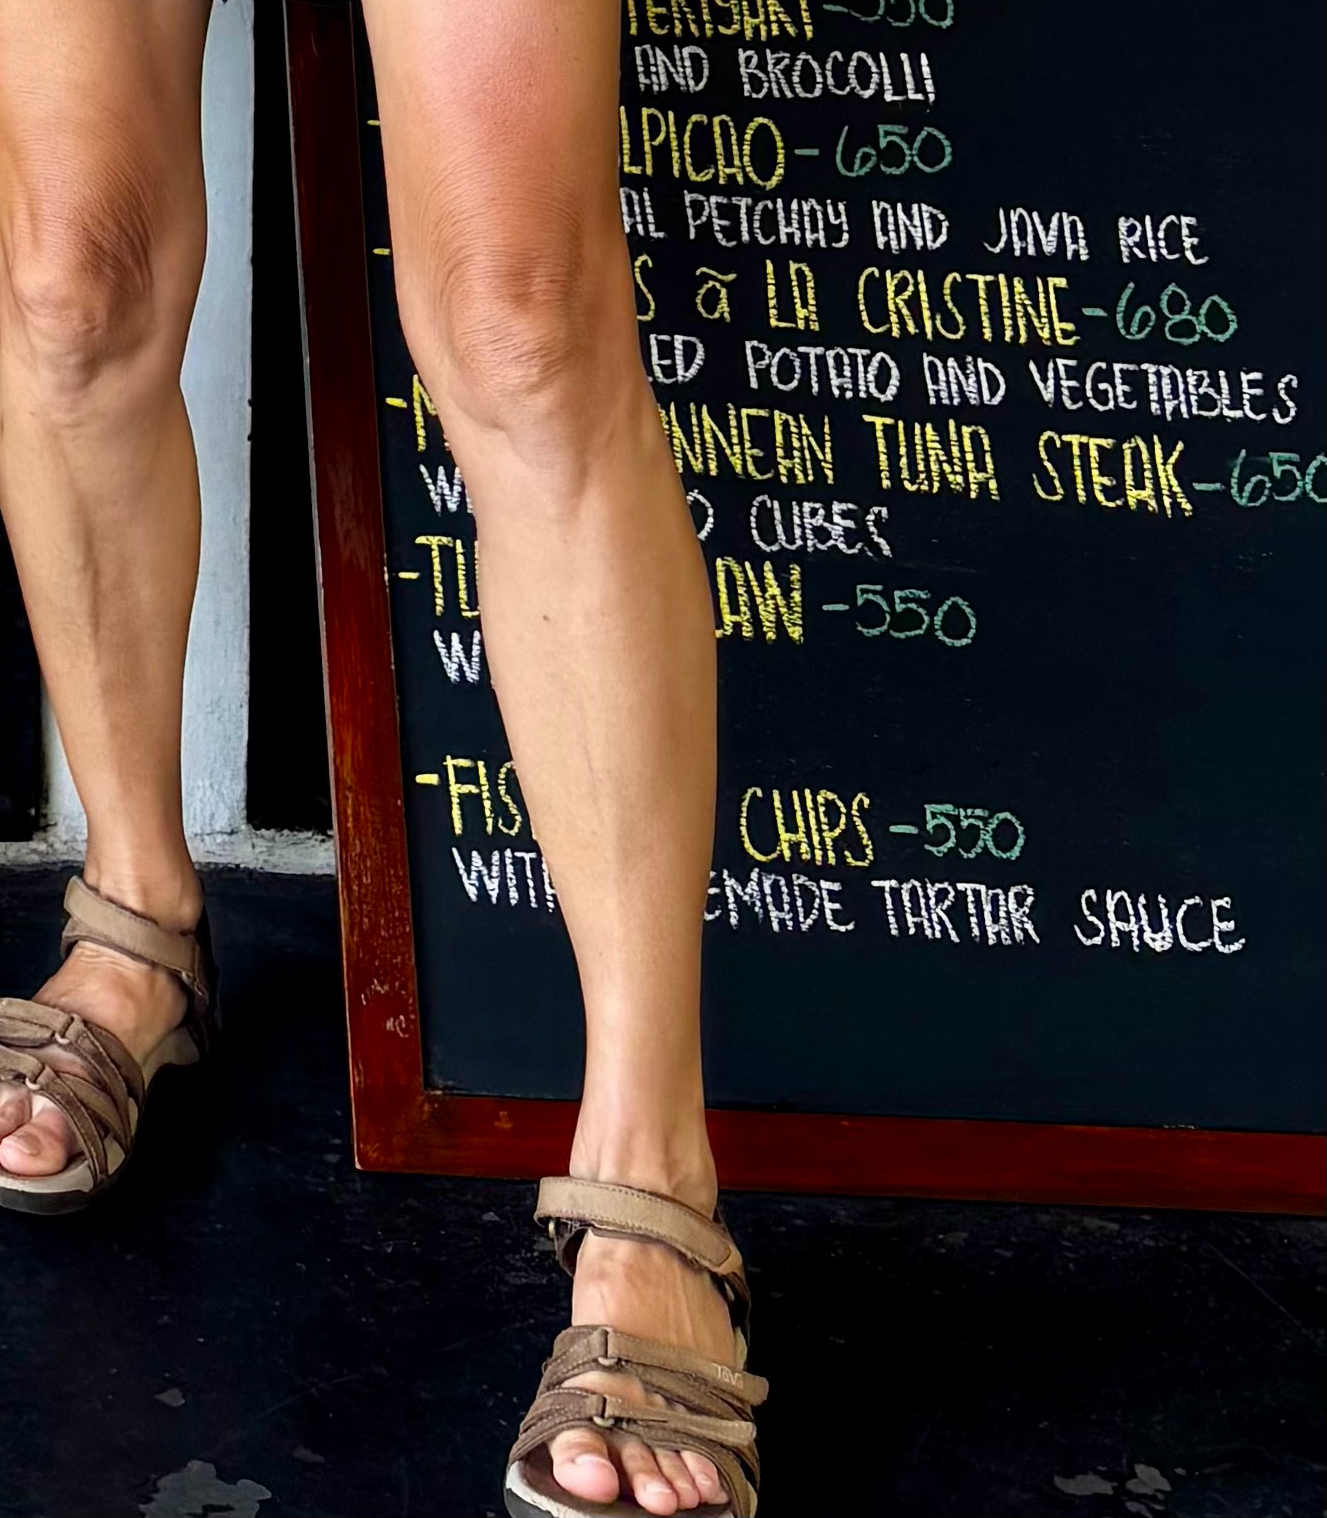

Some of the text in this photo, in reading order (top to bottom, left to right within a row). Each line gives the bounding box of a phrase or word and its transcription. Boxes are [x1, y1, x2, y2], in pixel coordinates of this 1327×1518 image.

[634, 45, 935, 103] AND BROCOLLI
[684, 190, 849, 248] PETCHAY
[872, 199, 949, 254] AND
[982, 207, 1089, 261] JAVA
[1118, 214, 1209, 265] RICE
[766, 260, 820, 332] LA
[857, 267, 1081, 346] CRISTINE
[648, 334, 1299, 424] ED POTATO AND VEGETABLES
[658, 402, 834, 485] NNEAN
[862, 414, 1000, 501] TUNA
[1033, 430, 1193, 518] STEAK
[750, 494, 893, 559] CUBES
[740, 786, 875, 867] CHIPS
[870, 880, 1040, 945] TARTAR
[1073, 888, 1246, 954] SAUCE
